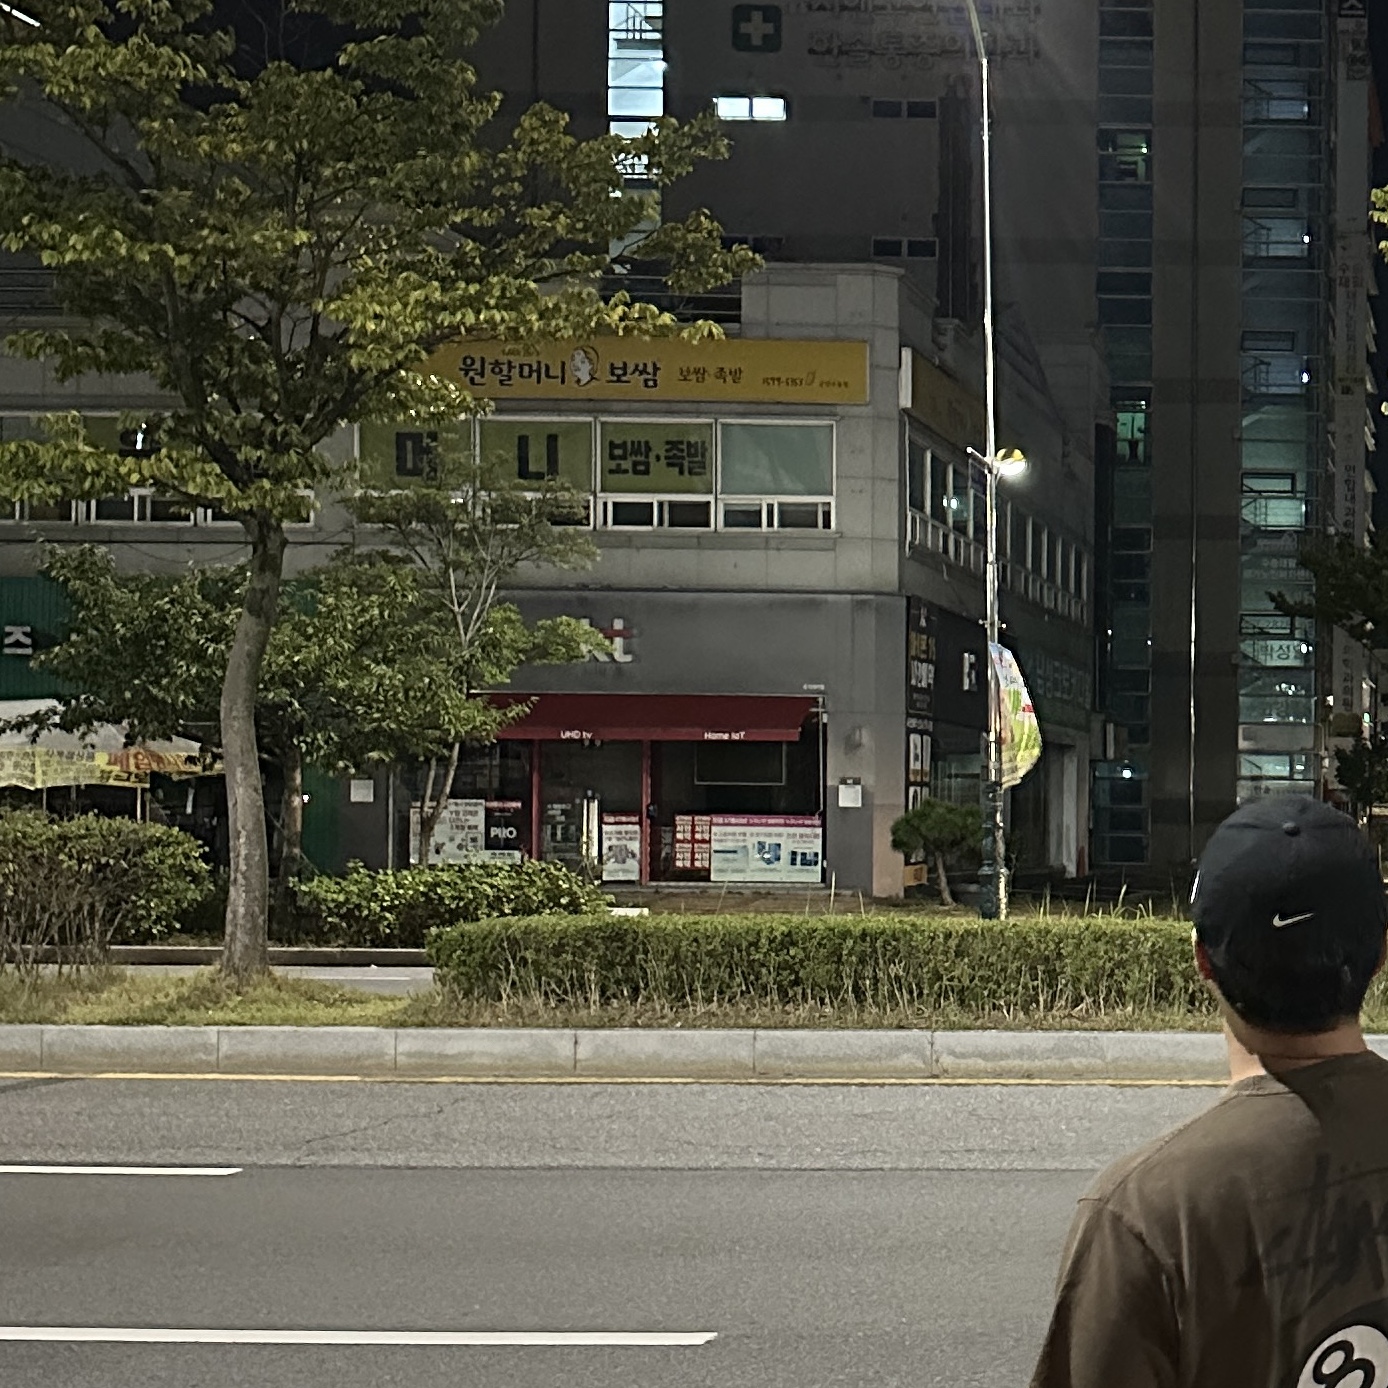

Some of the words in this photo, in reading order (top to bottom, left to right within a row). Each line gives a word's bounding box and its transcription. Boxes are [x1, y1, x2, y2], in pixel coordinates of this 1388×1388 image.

[458, 354, 566, 387] 원할머니
[605, 360, 662, 389] 보쌈
[560, 729, 582, 739] UHD
[704, 731, 730, 740] Home
